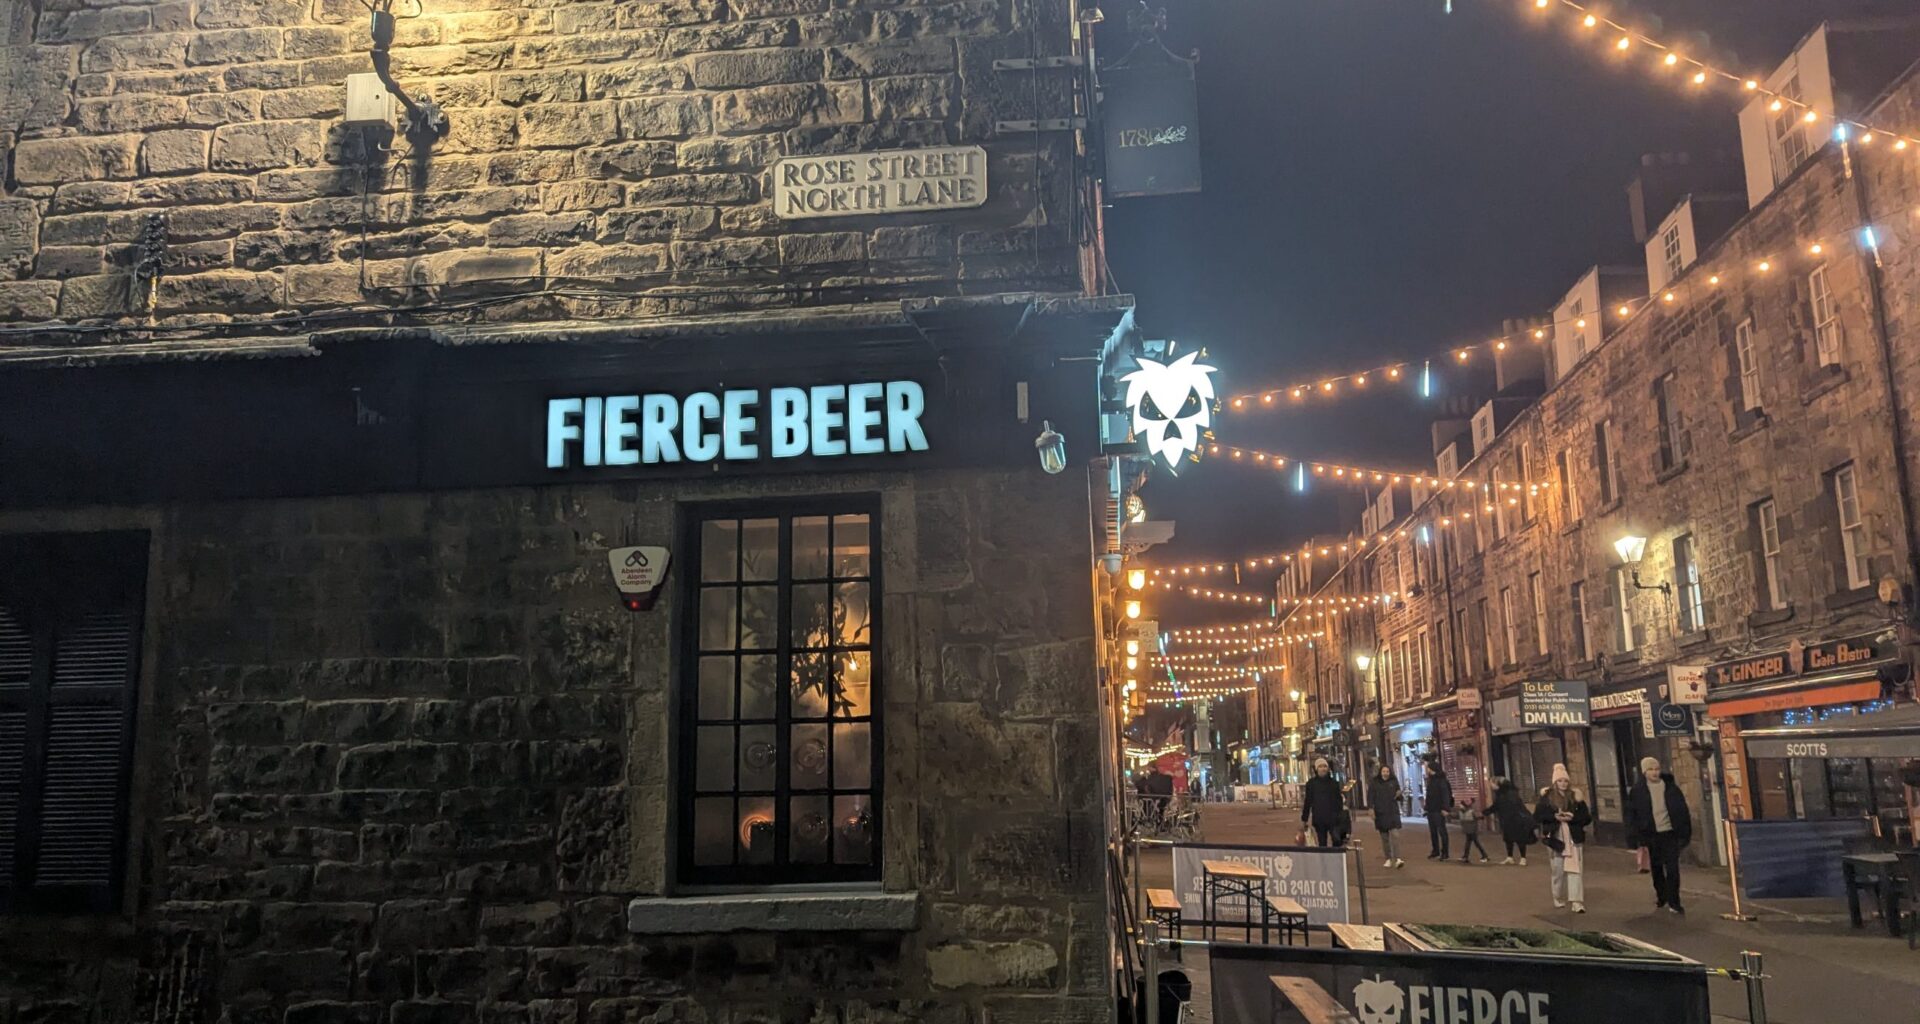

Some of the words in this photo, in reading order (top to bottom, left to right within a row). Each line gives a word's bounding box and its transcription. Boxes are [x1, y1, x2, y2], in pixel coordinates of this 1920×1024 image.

[783, 159, 856, 187] ROSE
[865, 150, 980, 182] STREET
[786, 183, 887, 214] NORTH
[896, 178, 977, 207] LANE
[546, 389, 759, 468] FIERCE
[771, 381, 930, 458] BEER
[1810, 649, 1837, 668] Cafe
[1837, 643, 1871, 663] Bistro
[1732, 656, 1784, 682] GINGER
[1522, 682, 1536, 692] To
[1537, 682, 1555, 692] Let
[1524, 712, 1548, 724] DM
[1549, 711, 1587, 724] HALL
[1786, 743, 1828, 757] SCOTTS
